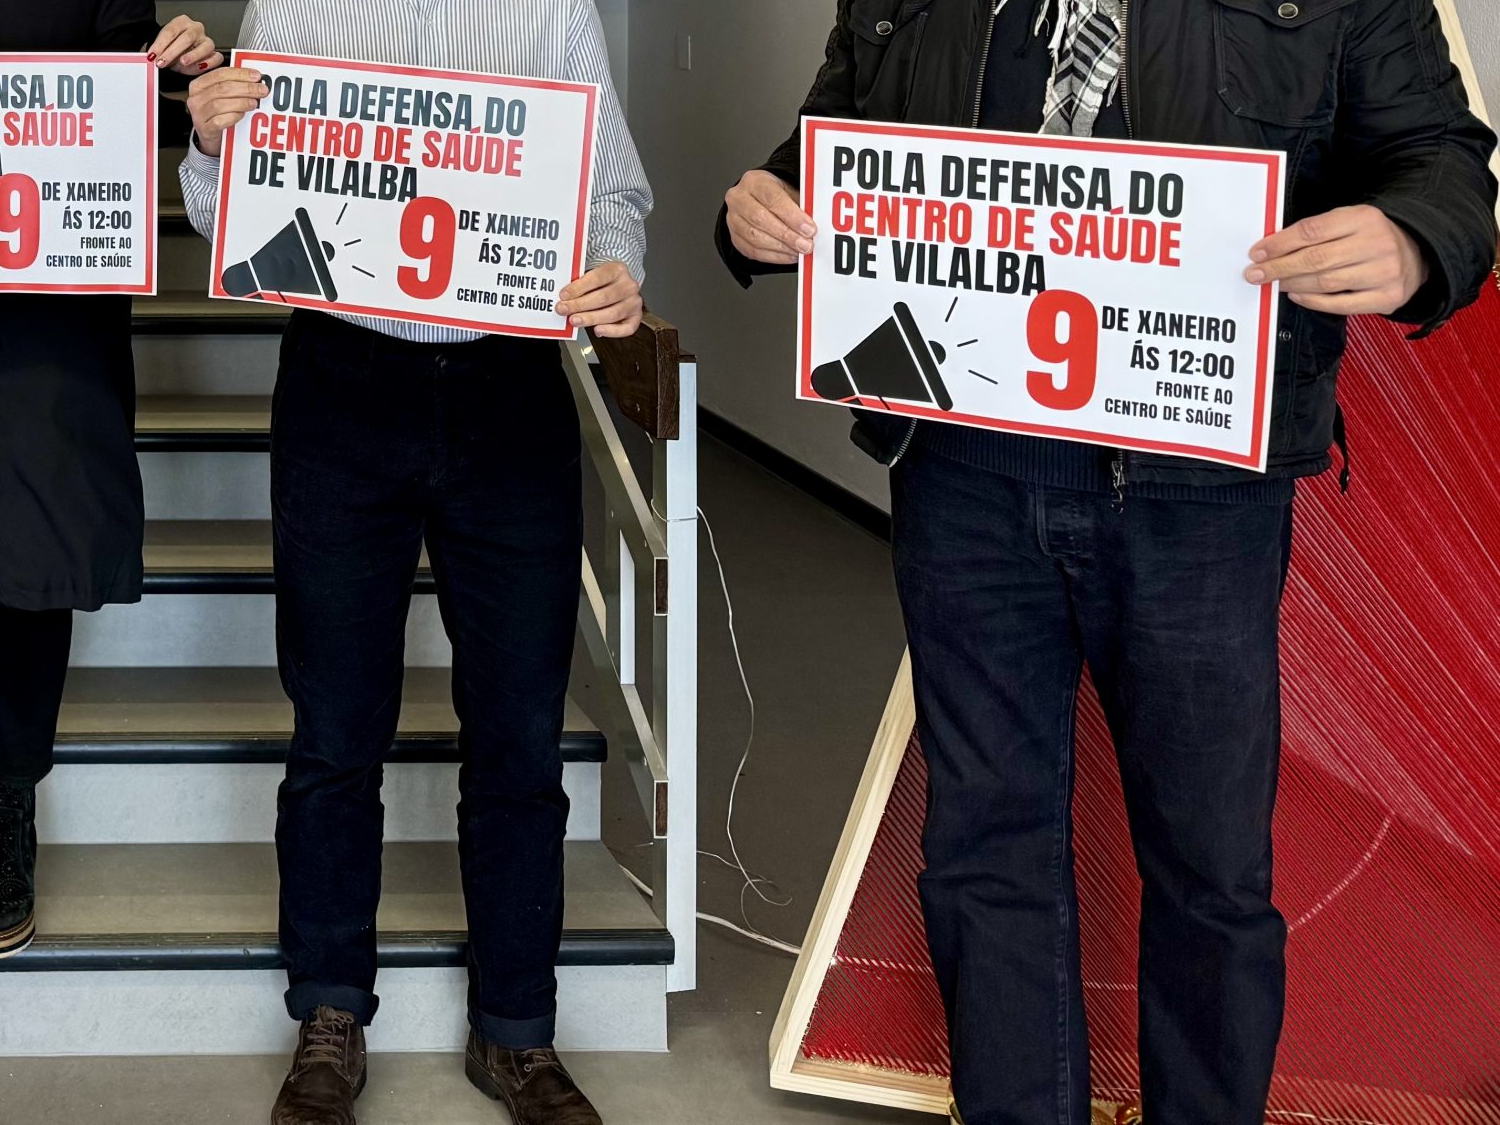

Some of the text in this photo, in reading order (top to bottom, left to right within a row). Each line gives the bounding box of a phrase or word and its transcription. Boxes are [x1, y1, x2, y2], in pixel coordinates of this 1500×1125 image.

[58, 75, 93, 109] DO
[339, 82, 471, 131] DEFENSA
[485, 97, 526, 136] DO
[4, 106, 92, 146] SAÚDE
[250, 113, 523, 177] CENTRO DE SAÚDE
[42, 182, 60, 201] DE
[67, 183, 131, 201] XANEIRO
[249, 150, 417, 202] DE VILALBA
[833, 146, 1183, 218] POLA DEFENSA DO
[63, 206, 131, 229] ÁS 12:00
[832, 192, 1181, 267] CENTRO DE SAÚDE
[46, 253, 131, 267] CENTRO DE SAÚDE
[81, 237, 131, 249] FRONTE AO
[398, 197, 559, 299] 9 DE XANEIRO
[479, 238, 556, 270] ÁS 12:00
[497, 273, 554, 292] FRONTE AO
[835, 234, 1045, 296] DE VILALBA
[457, 288, 553, 312] CENTRO DE SAÚDE
[1026, 290, 1236, 410] 9 DE XANEIRO
[1130, 340, 1234, 379] ÁS 12:00
[1156, 381, 1232, 405] FRONTE AO
[1105, 398, 1231, 429] CENTRO DE SAÚDE
